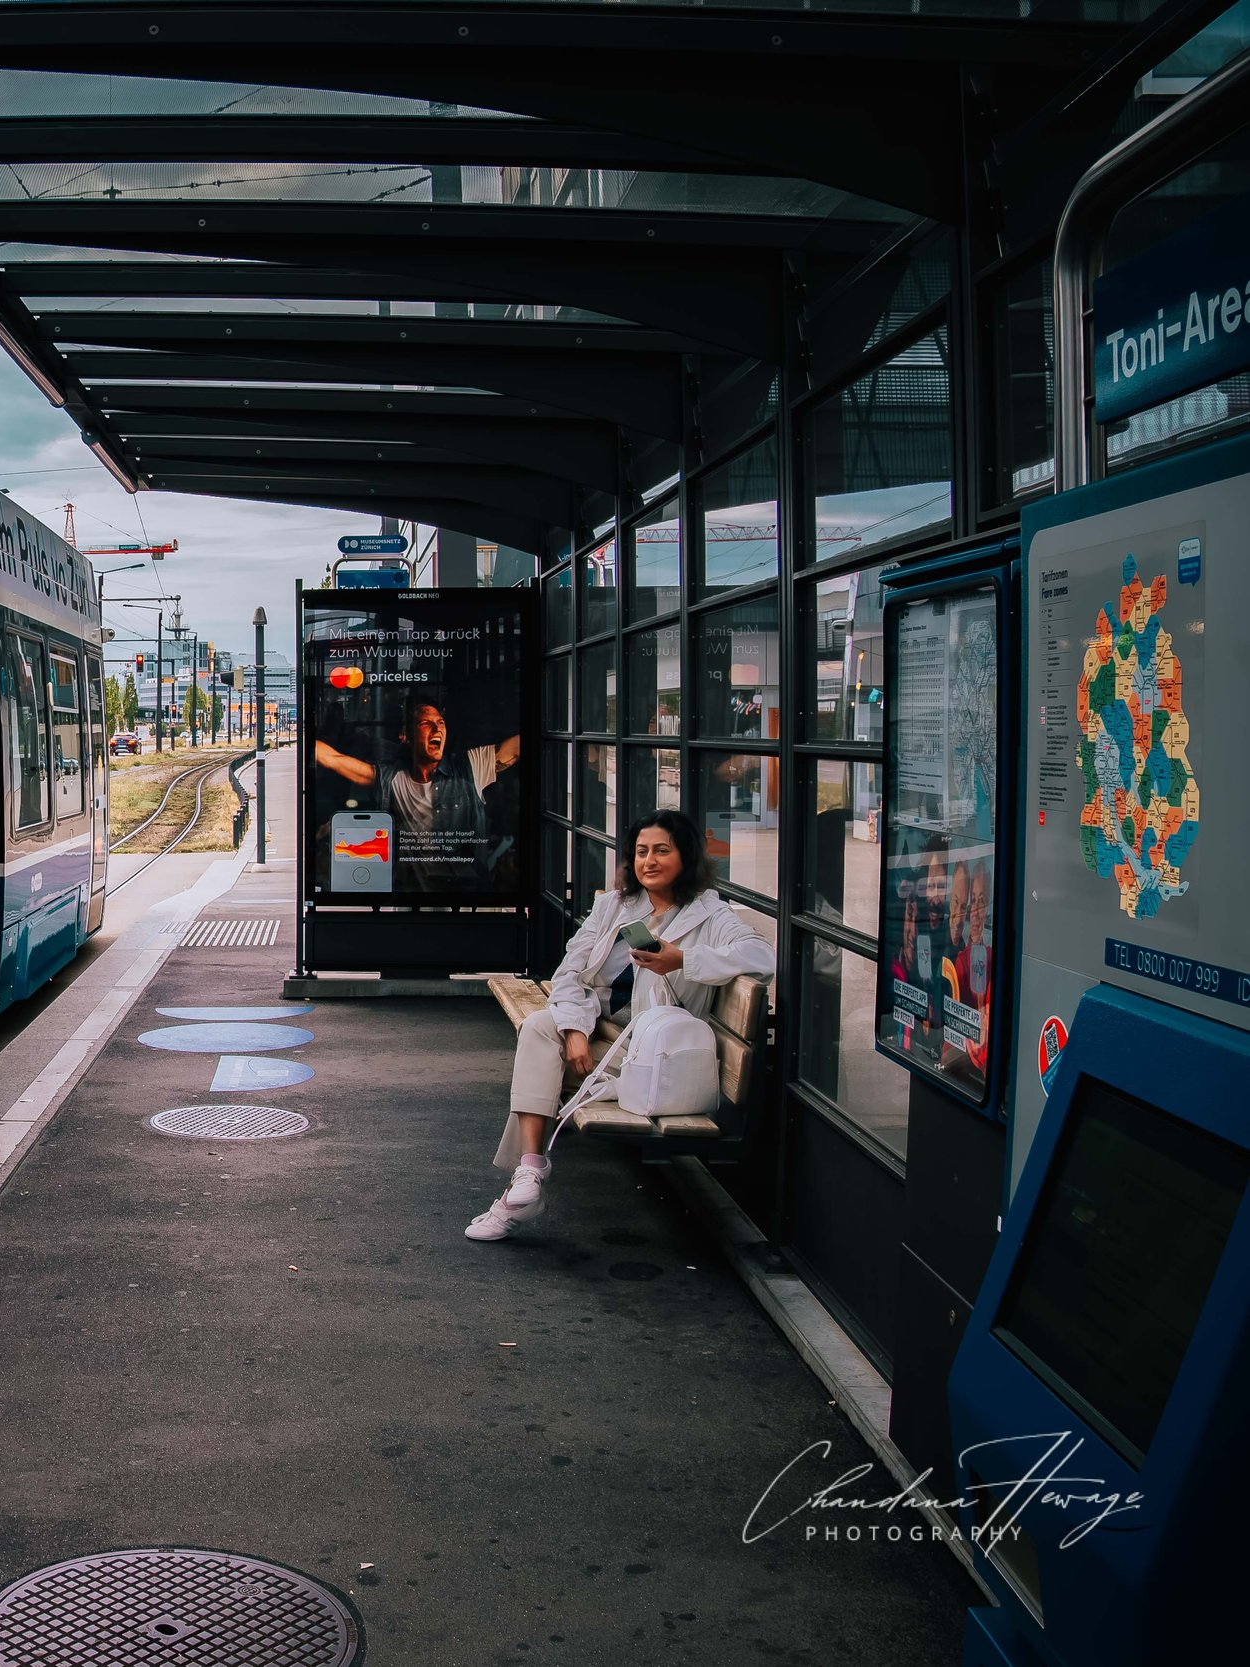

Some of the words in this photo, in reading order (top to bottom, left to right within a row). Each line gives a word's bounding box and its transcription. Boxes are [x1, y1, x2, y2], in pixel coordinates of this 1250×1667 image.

[1106, 277, 1250, 383] Toni-Are
[16, 516, 50, 597] Puls
[51, 556, 68, 606] vo
[329, 628, 352, 640] Mit
[357, 628, 400, 640] einem
[404, 628, 430, 642] Tap
[434, 628, 480, 640] zurück
[330, 648, 360, 658] zum
[370, 670, 428, 684] priceless
[1114, 944, 1132, 968] TEL
[1138, 950, 1166, 977] 0800
[1170, 959, 1192, 984] 007
[1196, 966, 1220, 992] 999
